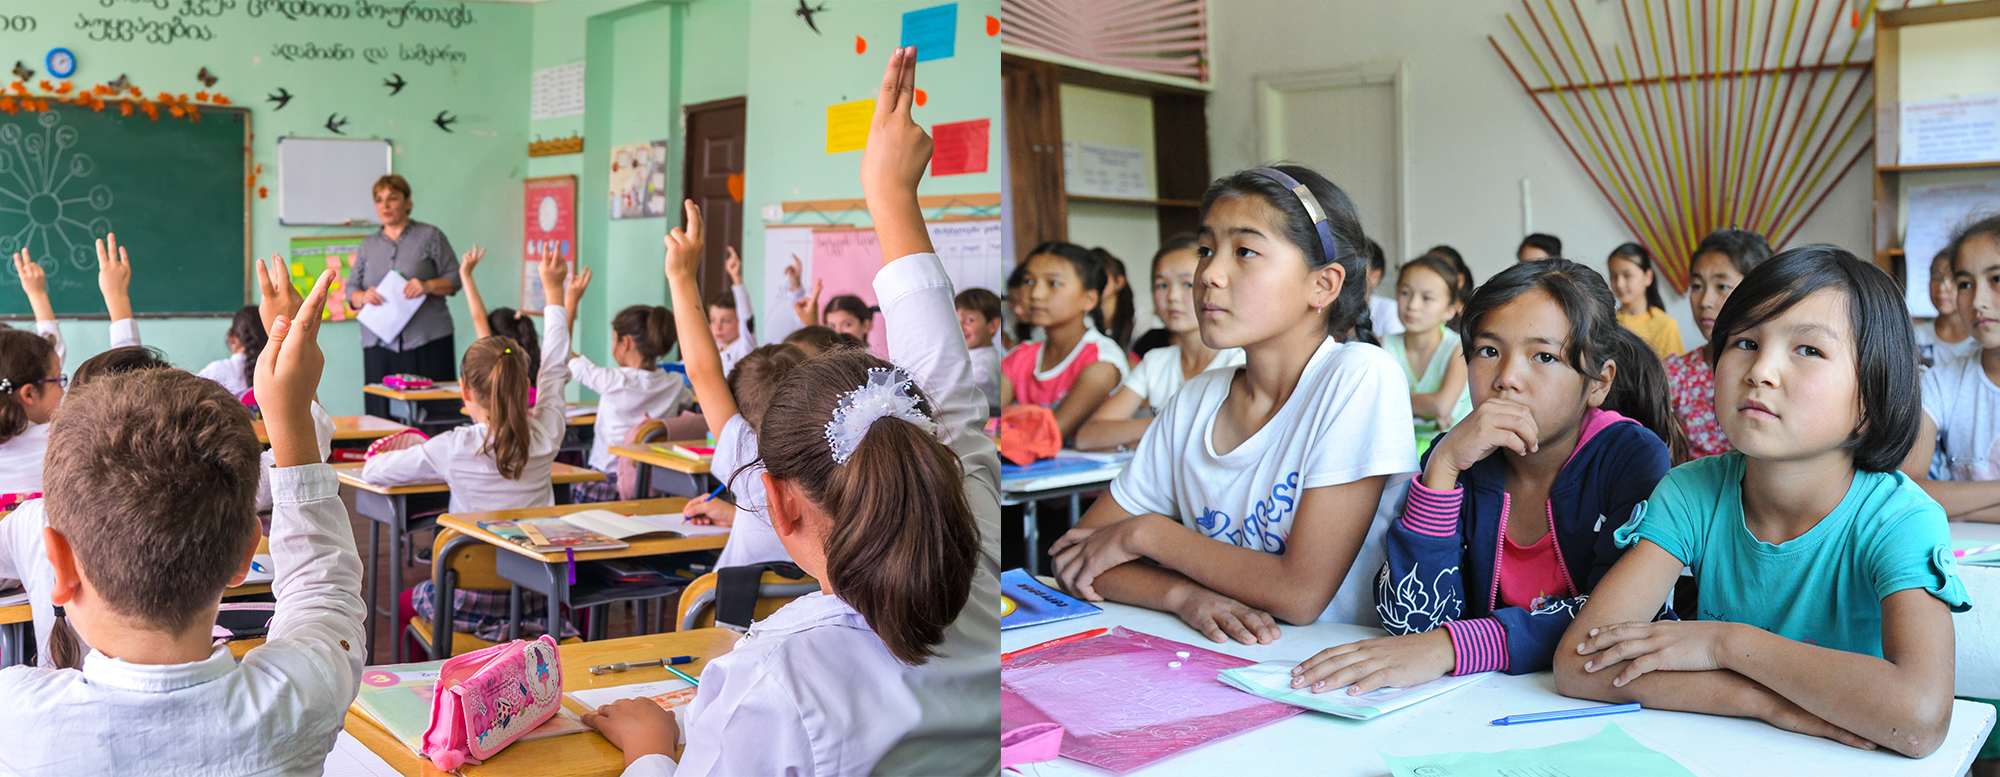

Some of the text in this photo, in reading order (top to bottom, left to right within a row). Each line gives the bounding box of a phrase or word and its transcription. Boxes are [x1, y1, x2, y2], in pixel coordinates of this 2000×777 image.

[270, 41, 467, 66] ადამიანი და სამყარო
[370, 674, 391, 683] 3
